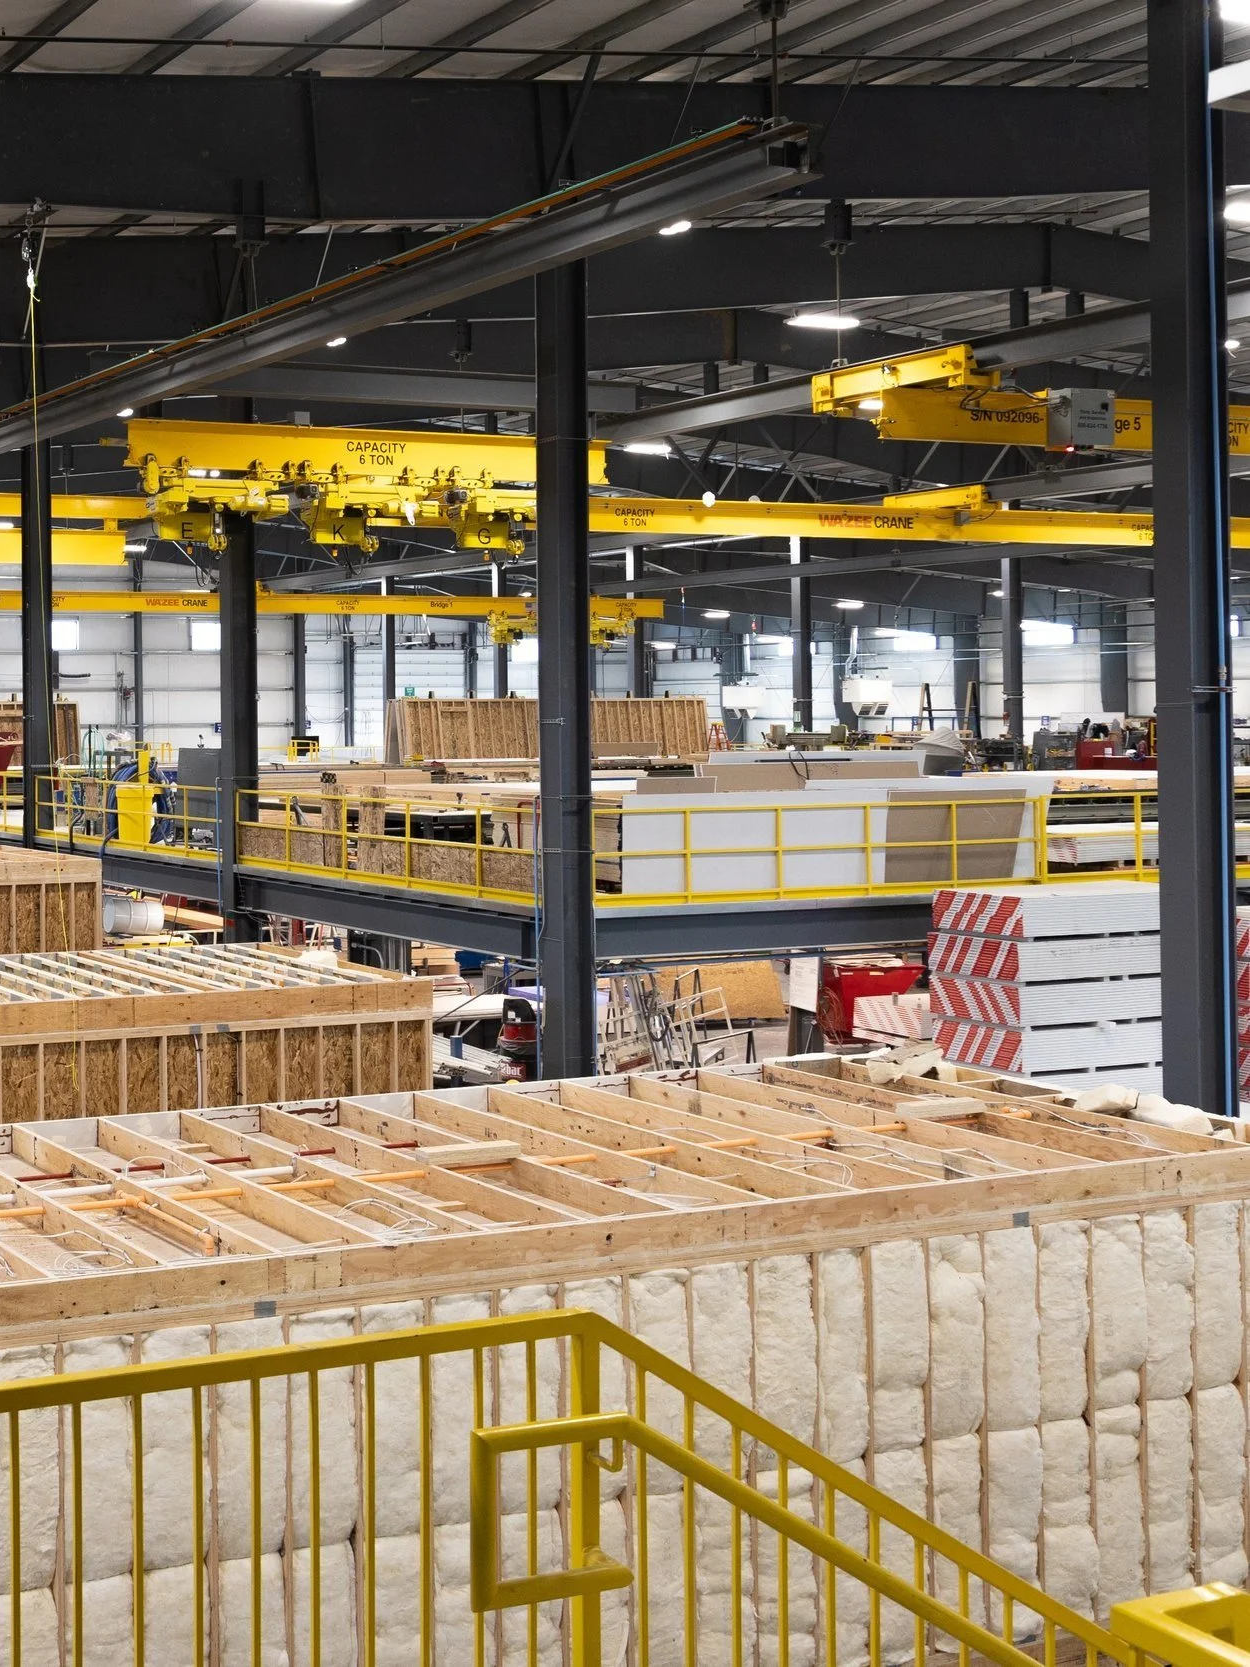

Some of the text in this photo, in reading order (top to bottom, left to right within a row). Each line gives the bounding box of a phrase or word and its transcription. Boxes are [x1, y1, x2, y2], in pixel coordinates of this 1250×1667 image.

[970, 410, 992, 422] S/N
[1134, 417, 1141, 429] 5
[346, 441, 406, 455] CAPACITY
[359, 455, 394, 466] 6 TON
[615, 508, 656, 518] CAPACITY
[623, 517, 647, 527] 6 TON
[818, 514, 914, 530] WAZEE CRANE
[182, 522, 194, 540] E
[333, 524, 345, 541] K
[478, 527, 491, 545] G
[145, 598, 208, 607] WAZEE CRANE
